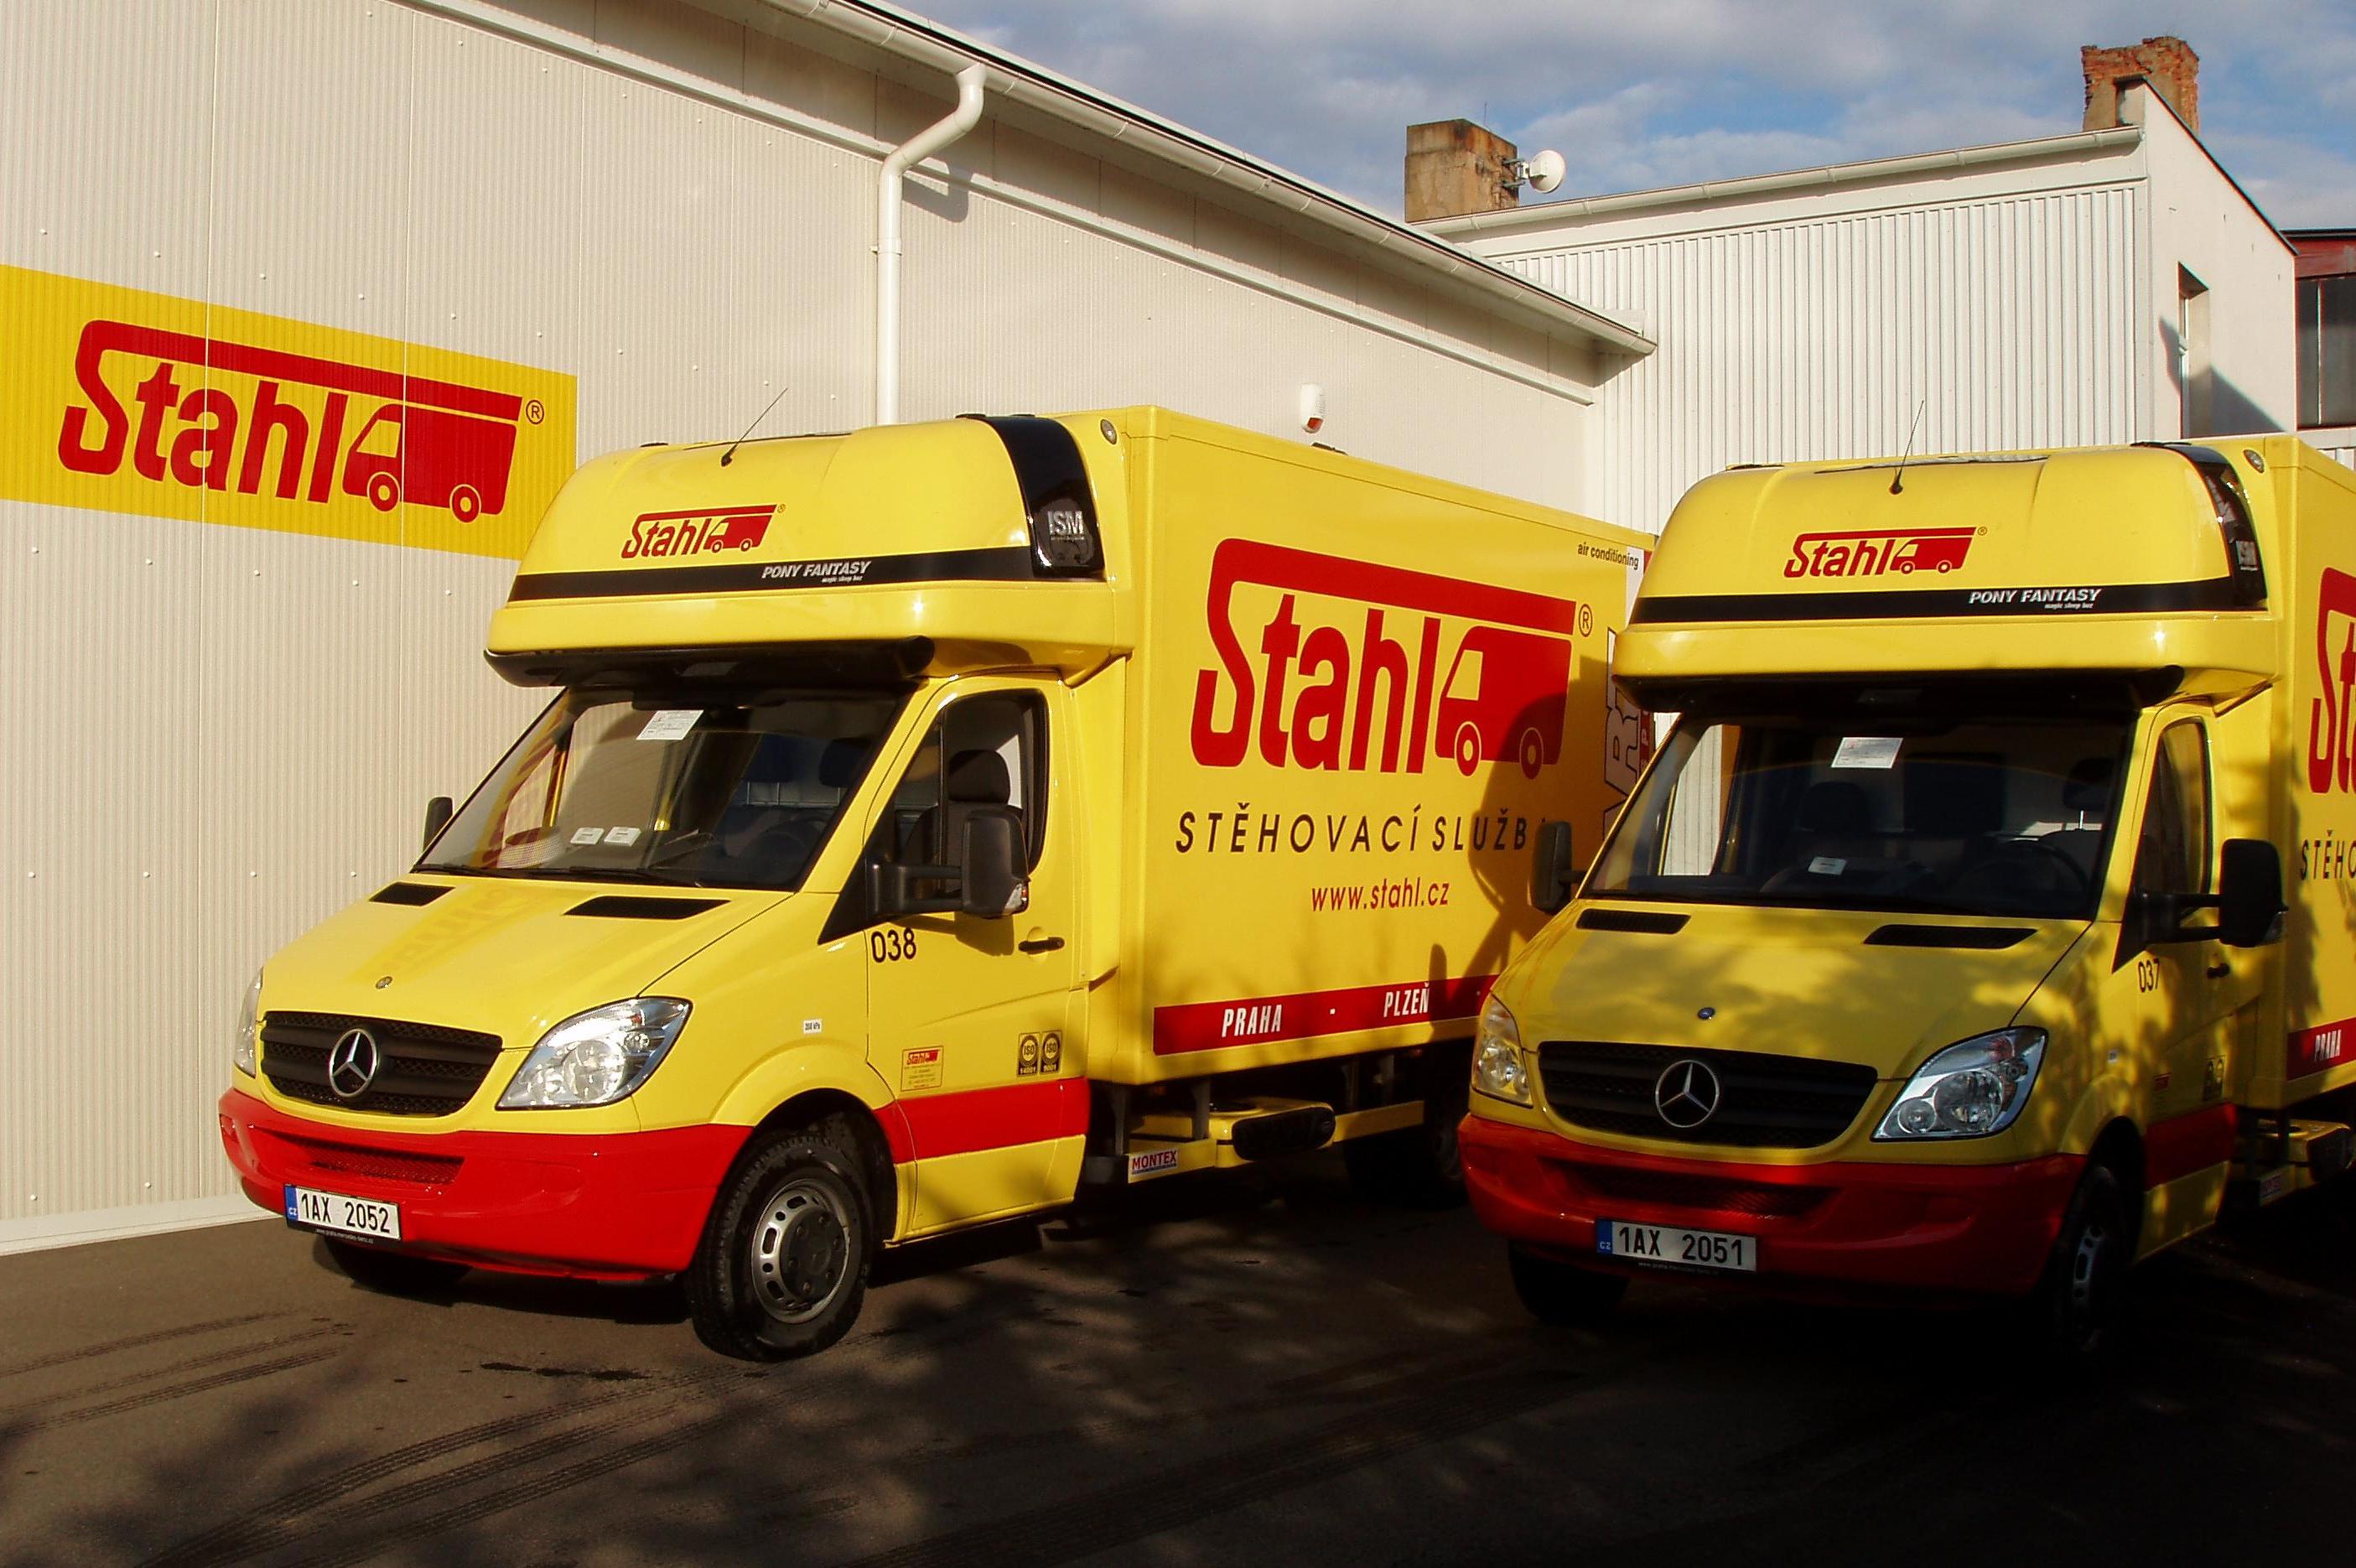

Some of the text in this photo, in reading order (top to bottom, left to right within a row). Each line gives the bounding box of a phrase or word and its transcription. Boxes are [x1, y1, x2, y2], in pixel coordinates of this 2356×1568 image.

[58, 319, 350, 506] Stahl
[621, 506, 713, 559] Stahl
[761, 560, 872, 579] PONY FANTASY
[1577, 542, 1639, 571] air conditioning
[1783, 531, 1897, 579] Stahl
[1969, 588, 2103, 605] PONY FANTASY
[1191, 537, 1441, 776] Stahl
[1175, 802, 1549, 854] STĚHOVACÍ SLUŽB
[1311, 876, 1450, 912] www.stahl.cz
[871, 927, 916, 963] 038
[2138, 958, 2161, 993] 037
[1222, 981, 1430, 1037] PRAHA PLZEŇ
[1132, 1150, 1177, 1171] MONTEX
[301, 1193, 331, 1223] 1AX
[345, 1202, 390, 1233] 2052
[1619, 1227, 1661, 1256] 1AX
[1682, 1233, 1742, 1266] 2051
